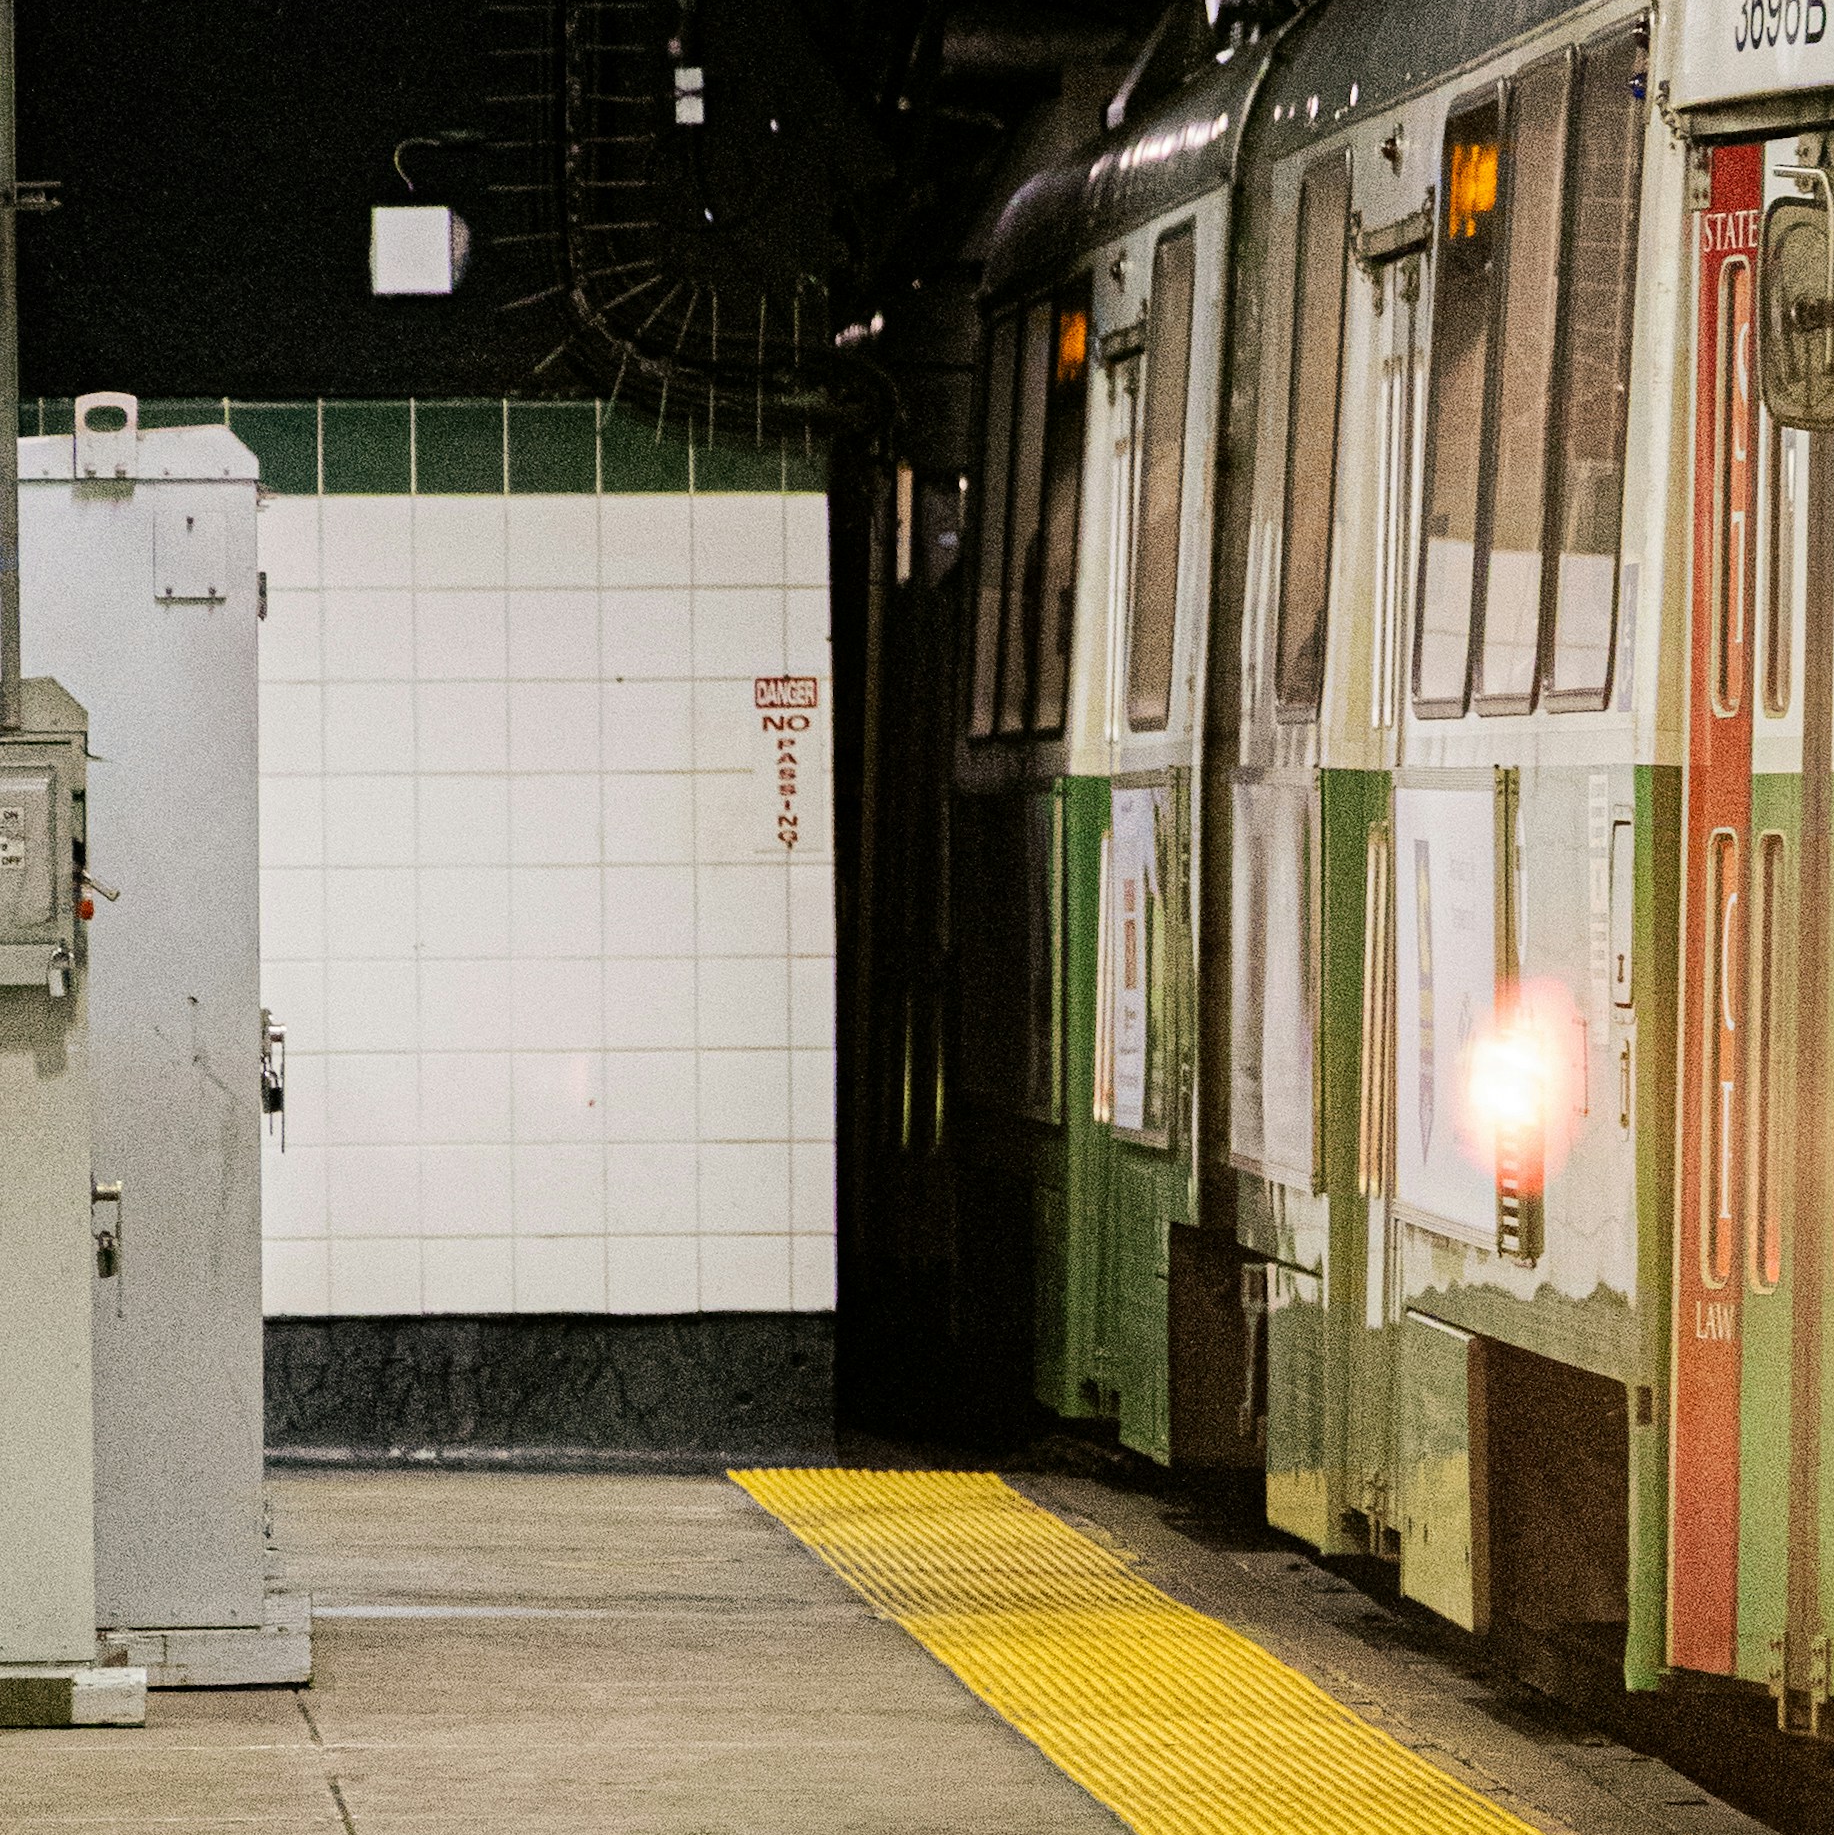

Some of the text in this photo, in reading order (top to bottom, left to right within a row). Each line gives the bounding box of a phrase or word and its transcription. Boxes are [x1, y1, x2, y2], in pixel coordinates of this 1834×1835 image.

[1703, 209, 1759, 253] STATE
[757, 678, 815, 706] DANGER
[762, 715, 810, 732] NO
